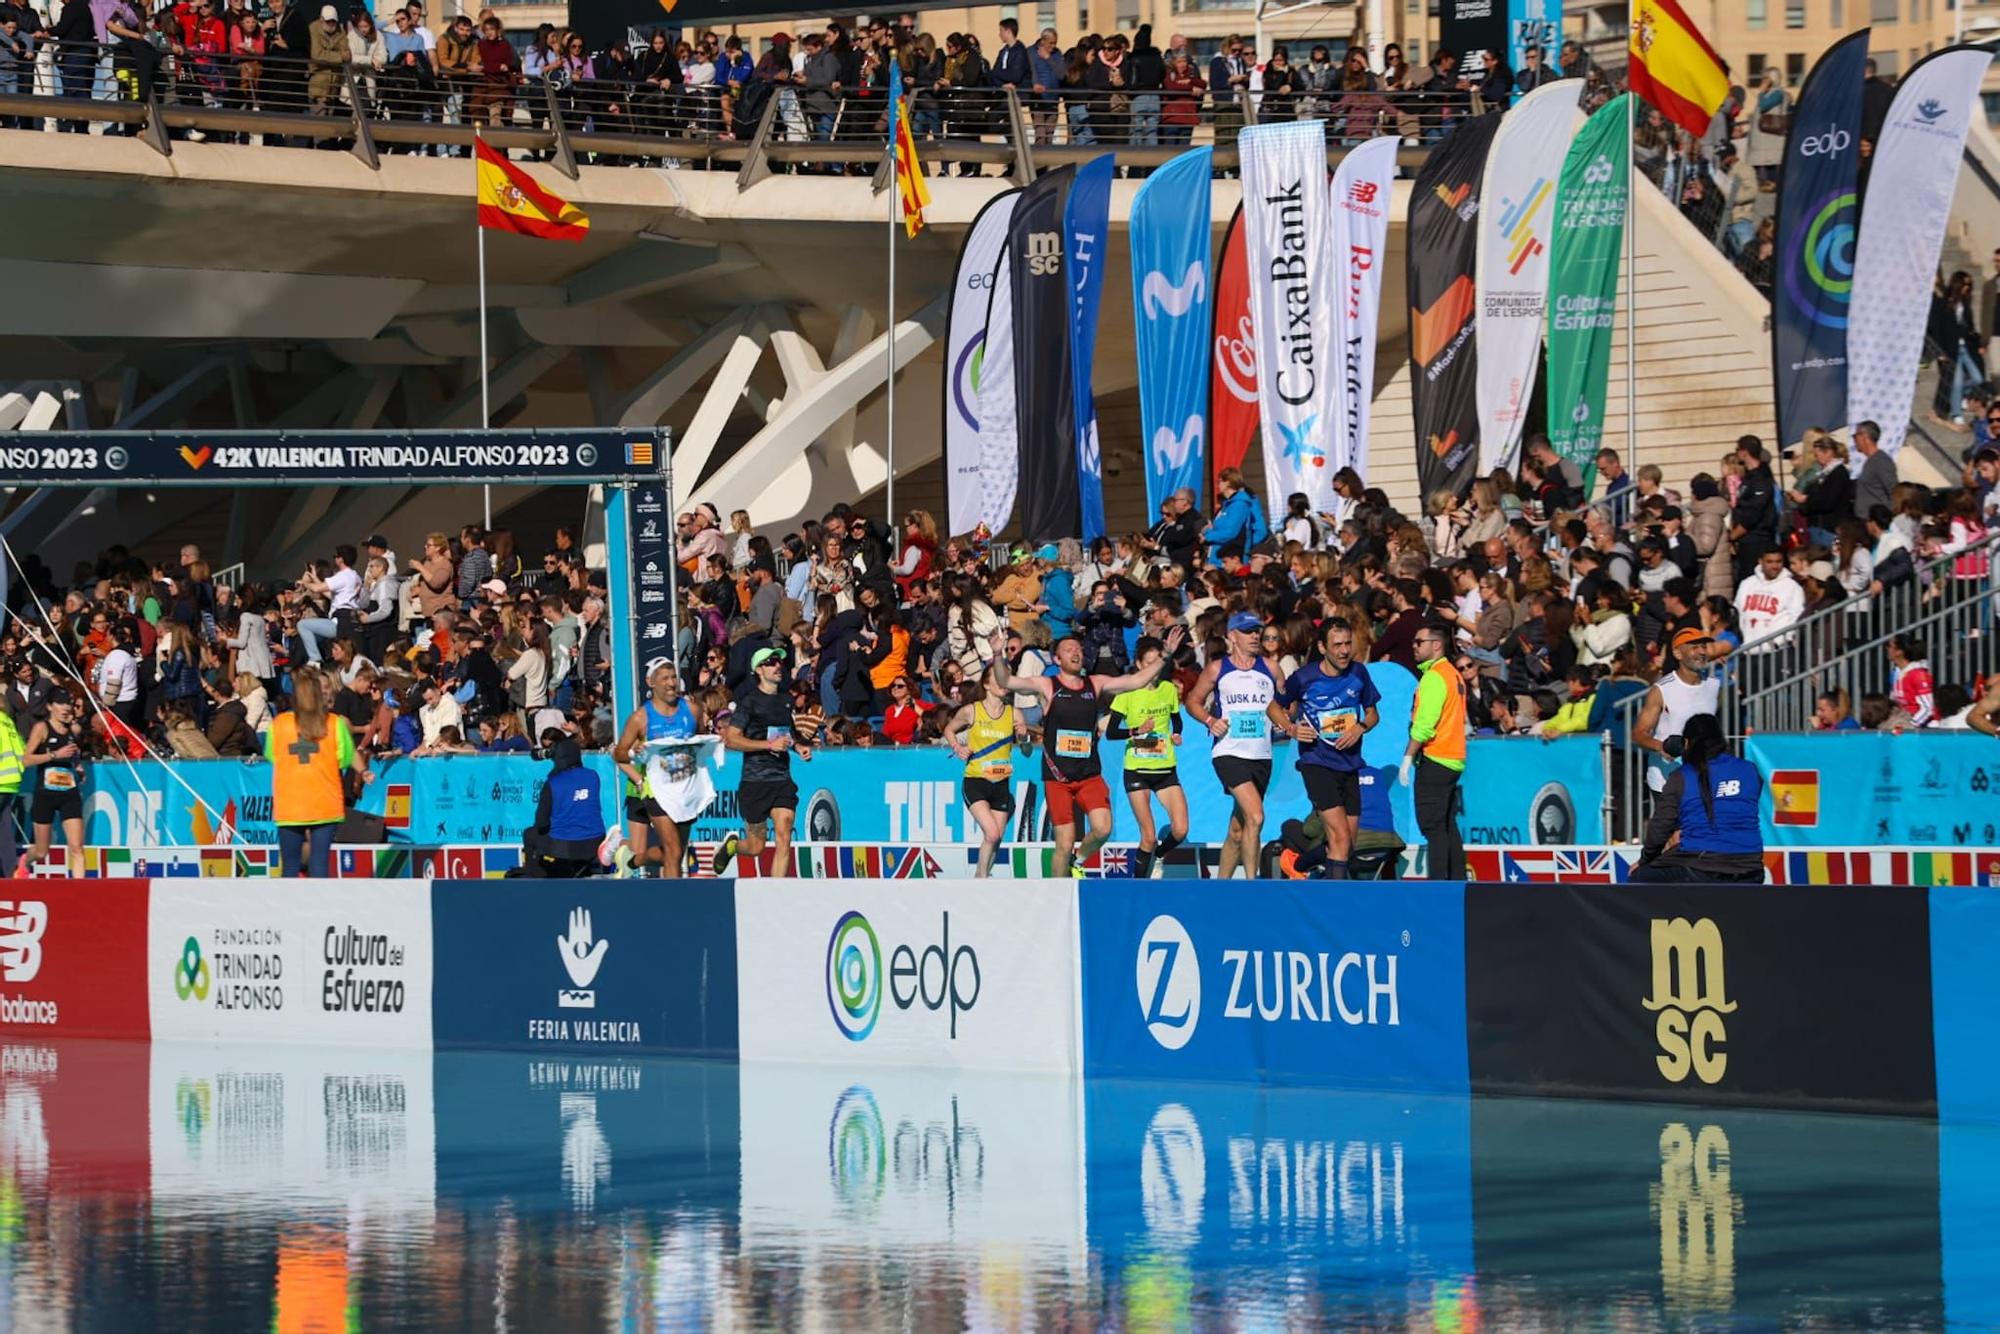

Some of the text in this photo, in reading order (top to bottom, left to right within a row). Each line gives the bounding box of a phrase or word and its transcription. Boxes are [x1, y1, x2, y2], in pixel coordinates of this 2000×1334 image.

[1800, 123, 1850, 160] edp
[1267, 177, 1316, 406] CaixaBank
[41, 448, 98, 469] 2023
[213, 445, 569, 468] 42K VALENCIA TRINIDAD ALFONSO 2023
[1226, 693, 1249, 704] LUSK
[215, 926, 282, 945] FUNDACIÓN
[324, 925, 405, 966] Cultura del
[215, 953, 282, 980] TRINIDAD
[889, 910, 981, 1040] edp
[215, 985, 283, 1010] ALFONSO
[323, 968, 405, 1013] Esfuerzo
[1222, 949, 1400, 1026] ZURICH
[529, 1019, 641, 1042] FERIA VALENCIA
